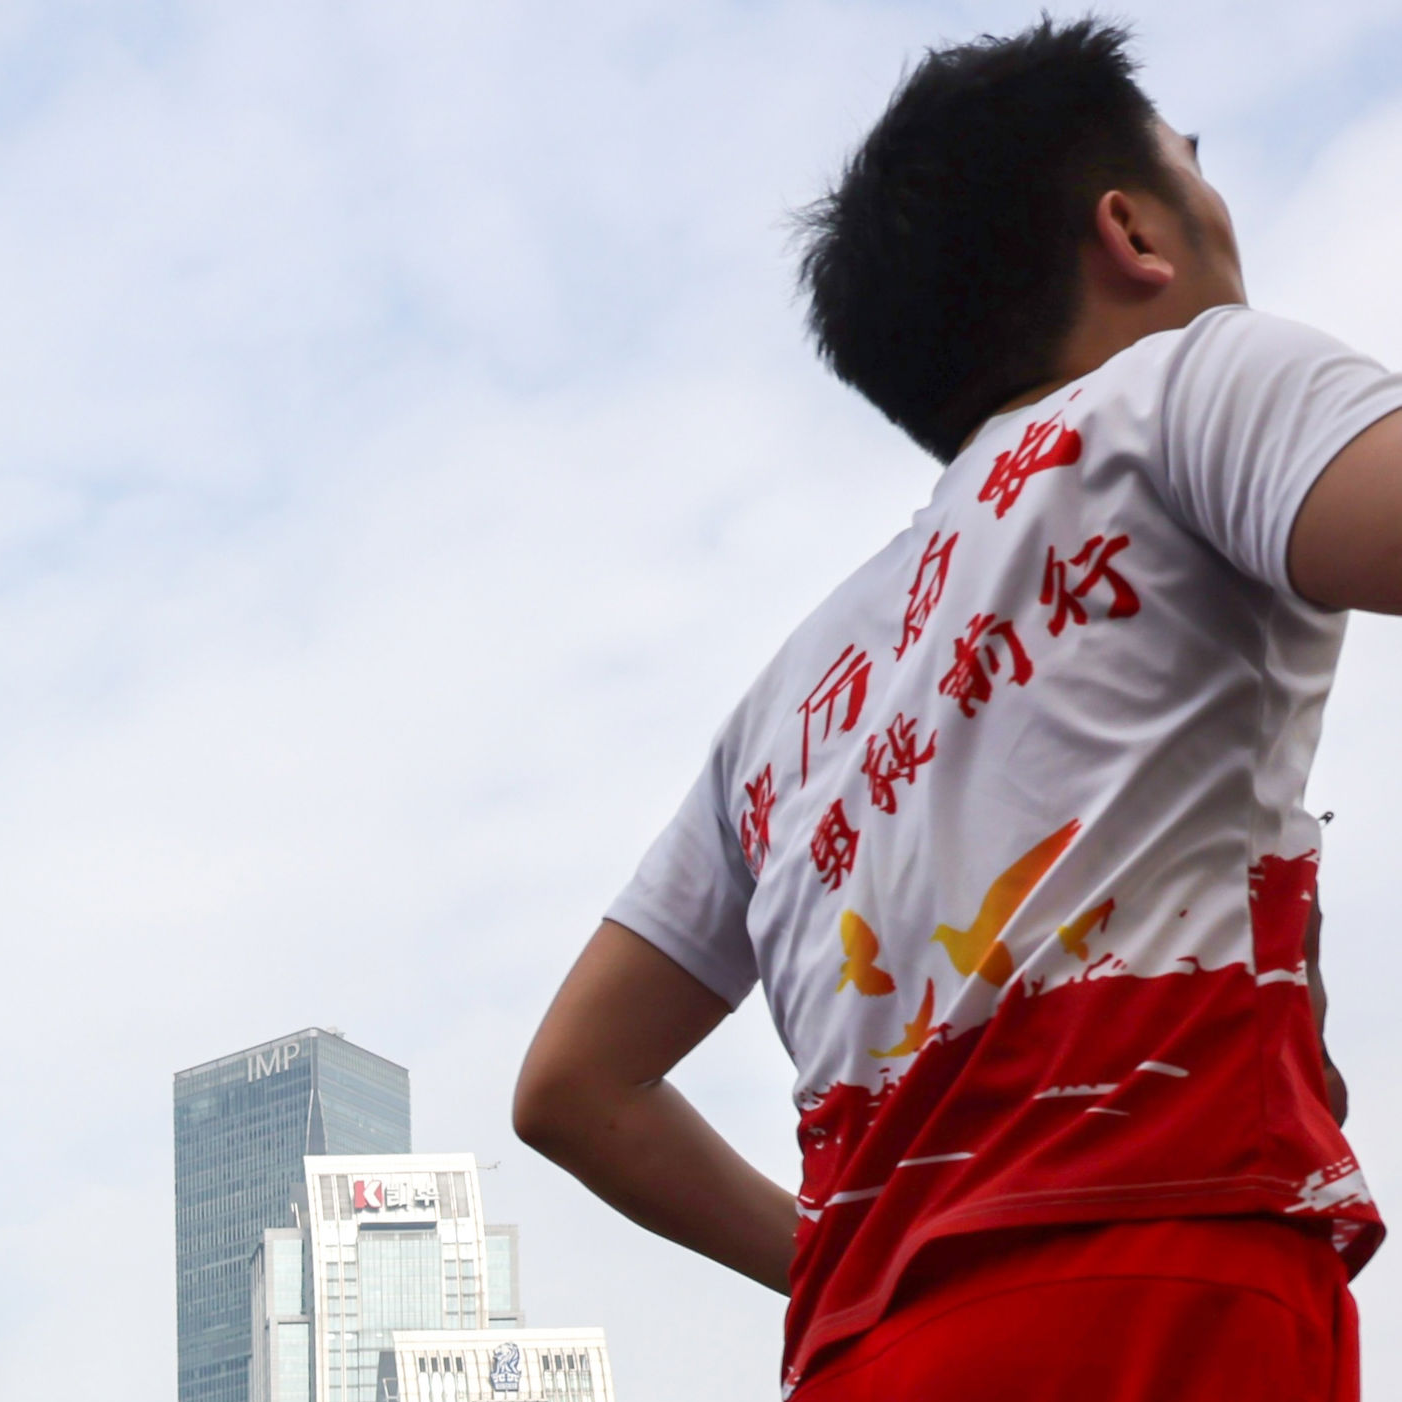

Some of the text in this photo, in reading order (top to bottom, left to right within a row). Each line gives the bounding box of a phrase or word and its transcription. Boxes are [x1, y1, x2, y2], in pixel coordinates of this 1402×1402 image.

[809, 534, 1142, 894] 勇毅前行
[247, 1043, 300, 1082] IMP
